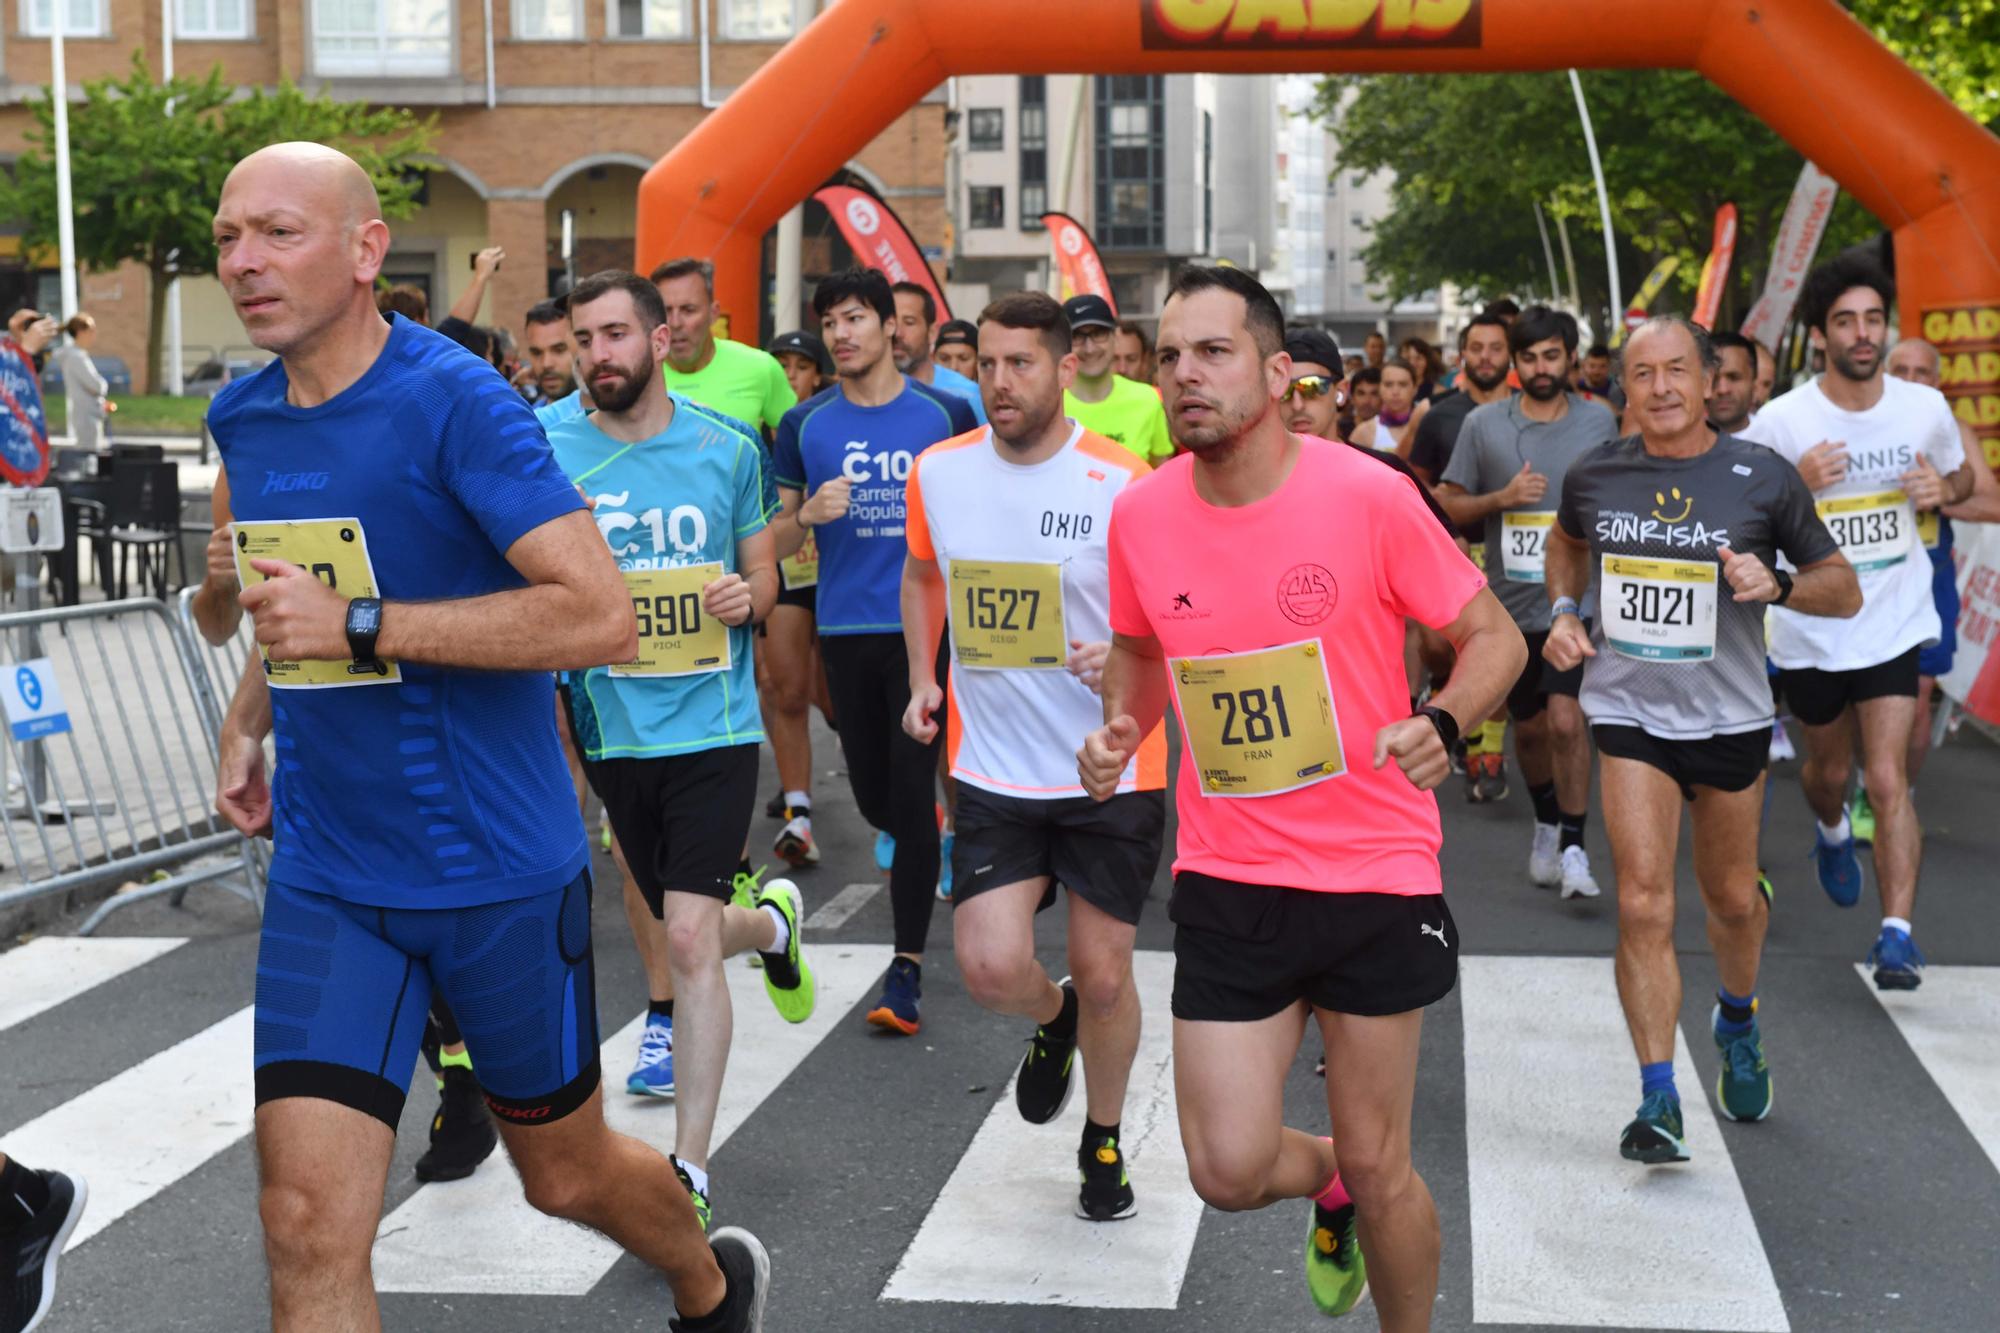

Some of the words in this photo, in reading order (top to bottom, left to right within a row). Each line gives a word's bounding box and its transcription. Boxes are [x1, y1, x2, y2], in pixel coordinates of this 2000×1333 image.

[1596, 516, 1731, 549] SONRISAS
[1831, 510, 1899, 547] 3033
[967, 587, 1040, 631] 1527
[1620, 582, 1694, 626] 3021
[1212, 684, 1291, 745] 281
[1244, 749, 1273, 761] FRAN
